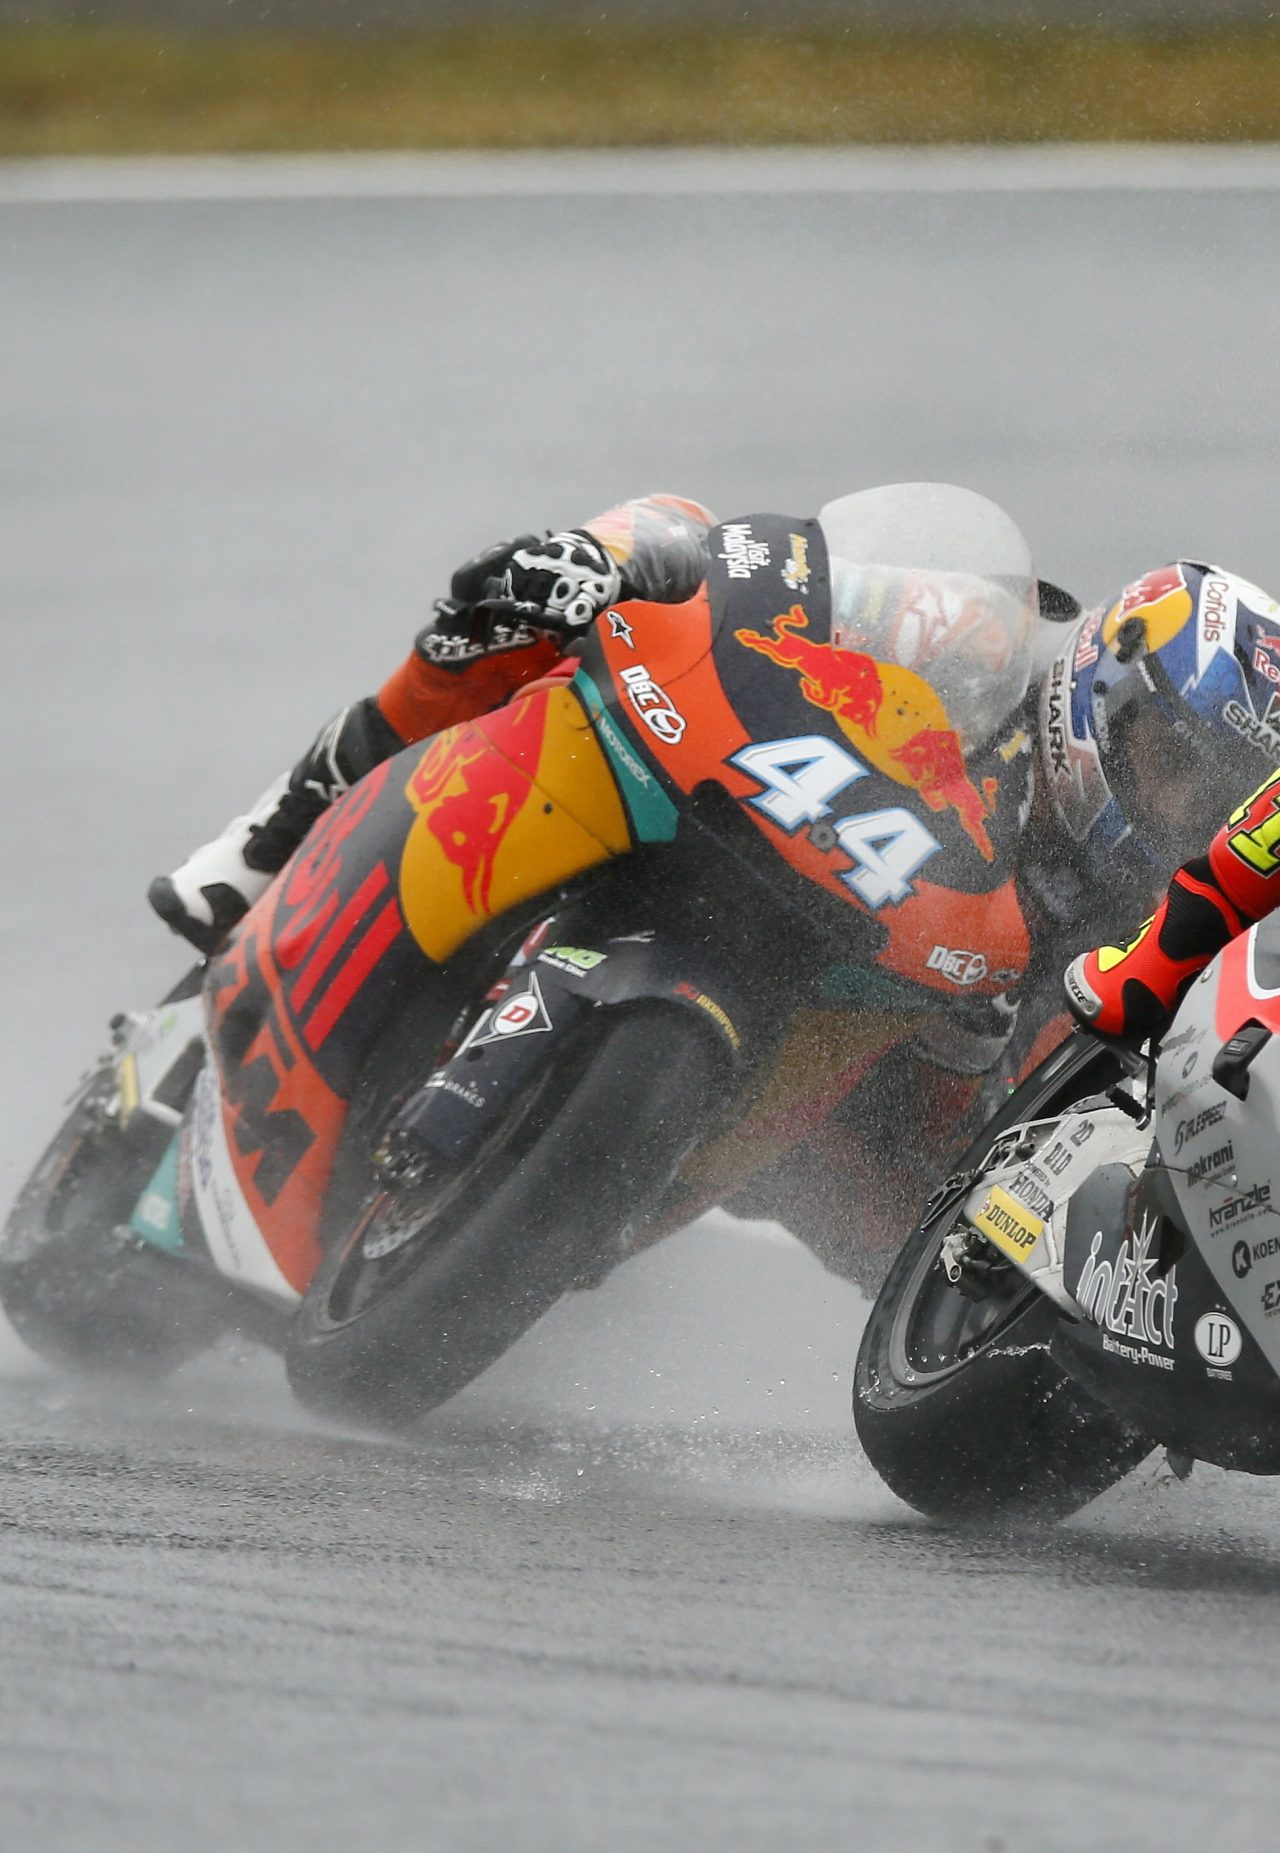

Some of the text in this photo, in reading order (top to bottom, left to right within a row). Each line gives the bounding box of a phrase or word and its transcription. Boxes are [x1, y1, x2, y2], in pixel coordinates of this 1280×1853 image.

[717, 523, 755, 579] Malaysia
[747, 542, 771, 570] Visit
[1204, 580, 1229, 644] Cofidis
[1049, 656, 1072, 778] SHARK
[501, 1006, 531, 1023] D
[1008, 1171, 1055, 1224] HONDA
[986, 1204, 1037, 1248] DUNLOP
[1102, 1334, 1176, 1371] Battery-Power
[1208, 1323, 1231, 1358] LP
